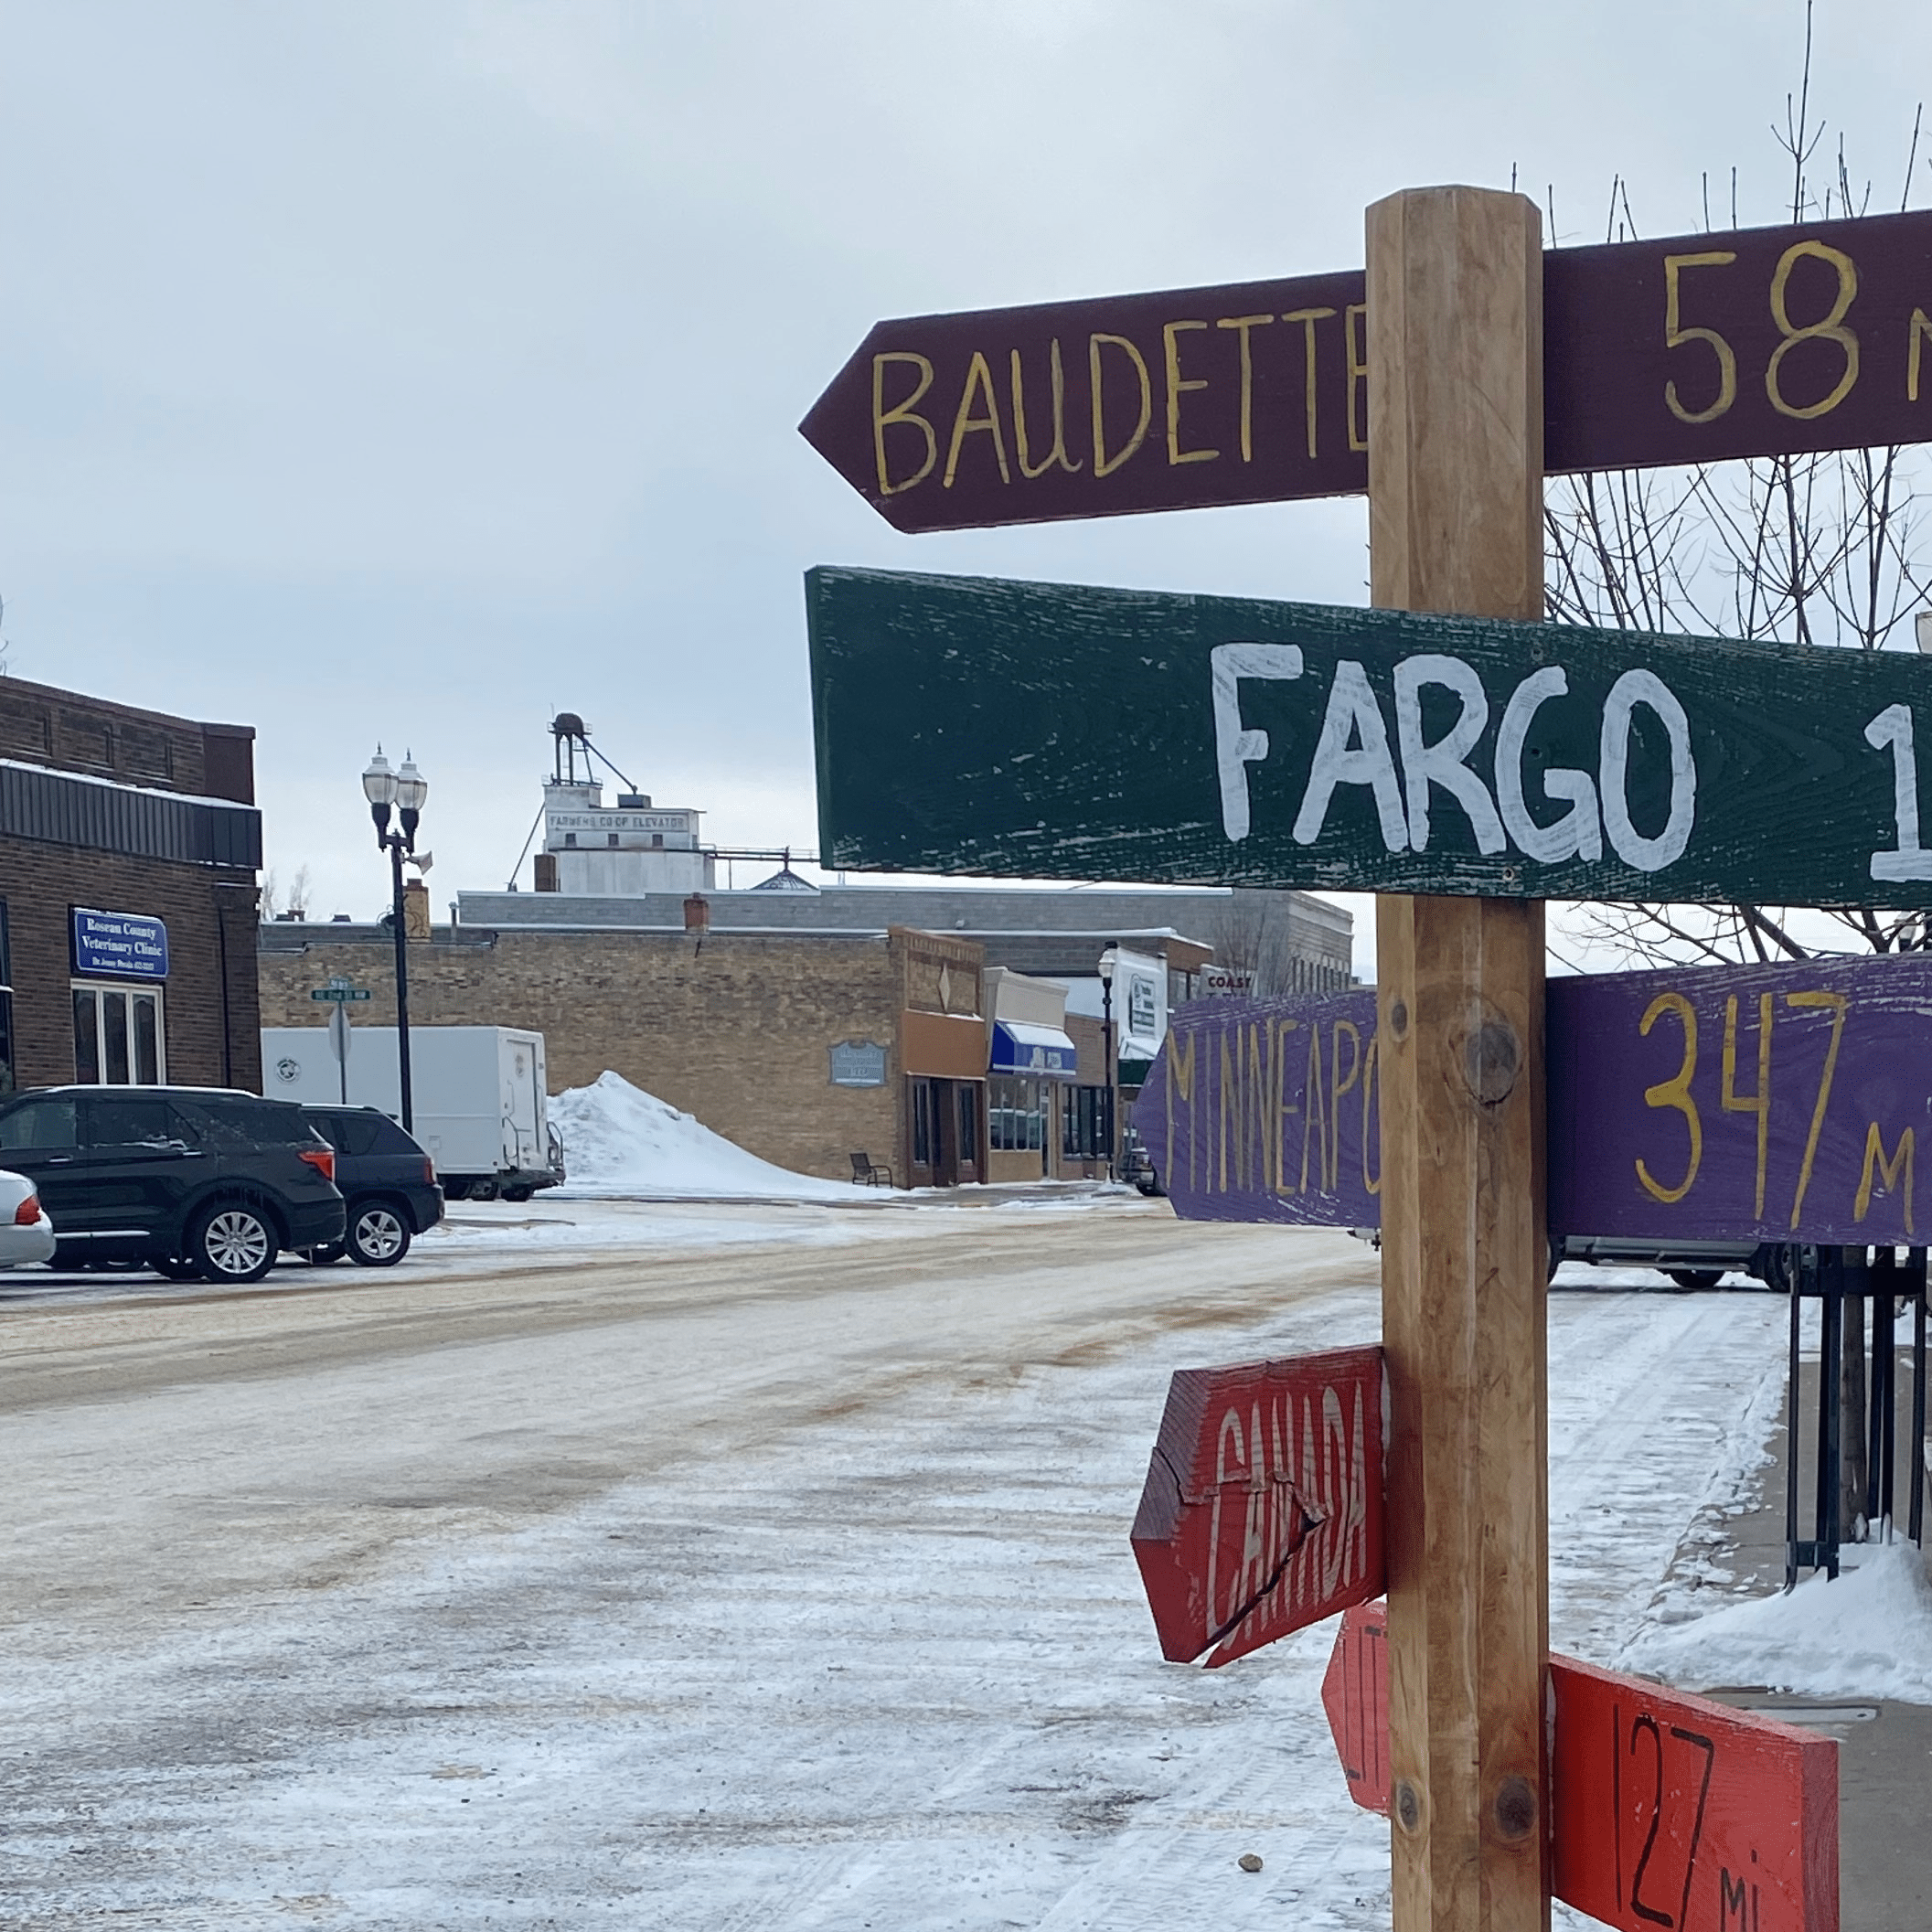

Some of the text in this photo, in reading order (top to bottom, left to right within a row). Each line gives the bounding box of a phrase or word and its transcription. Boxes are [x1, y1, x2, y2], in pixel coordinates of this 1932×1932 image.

[1664, 240, 1861, 423] 58
[1211, 642, 1698, 872] FARGO
[633, 817, 684, 827] ELEVATOR
[81, 934, 163, 956] Veterinary Clinic
[123, 923, 156, 940] County
[1208, 977, 1251, 988] COAST
[1635, 992, 1848, 1232] 347
[1613, 1703, 1715, 1932] 127
